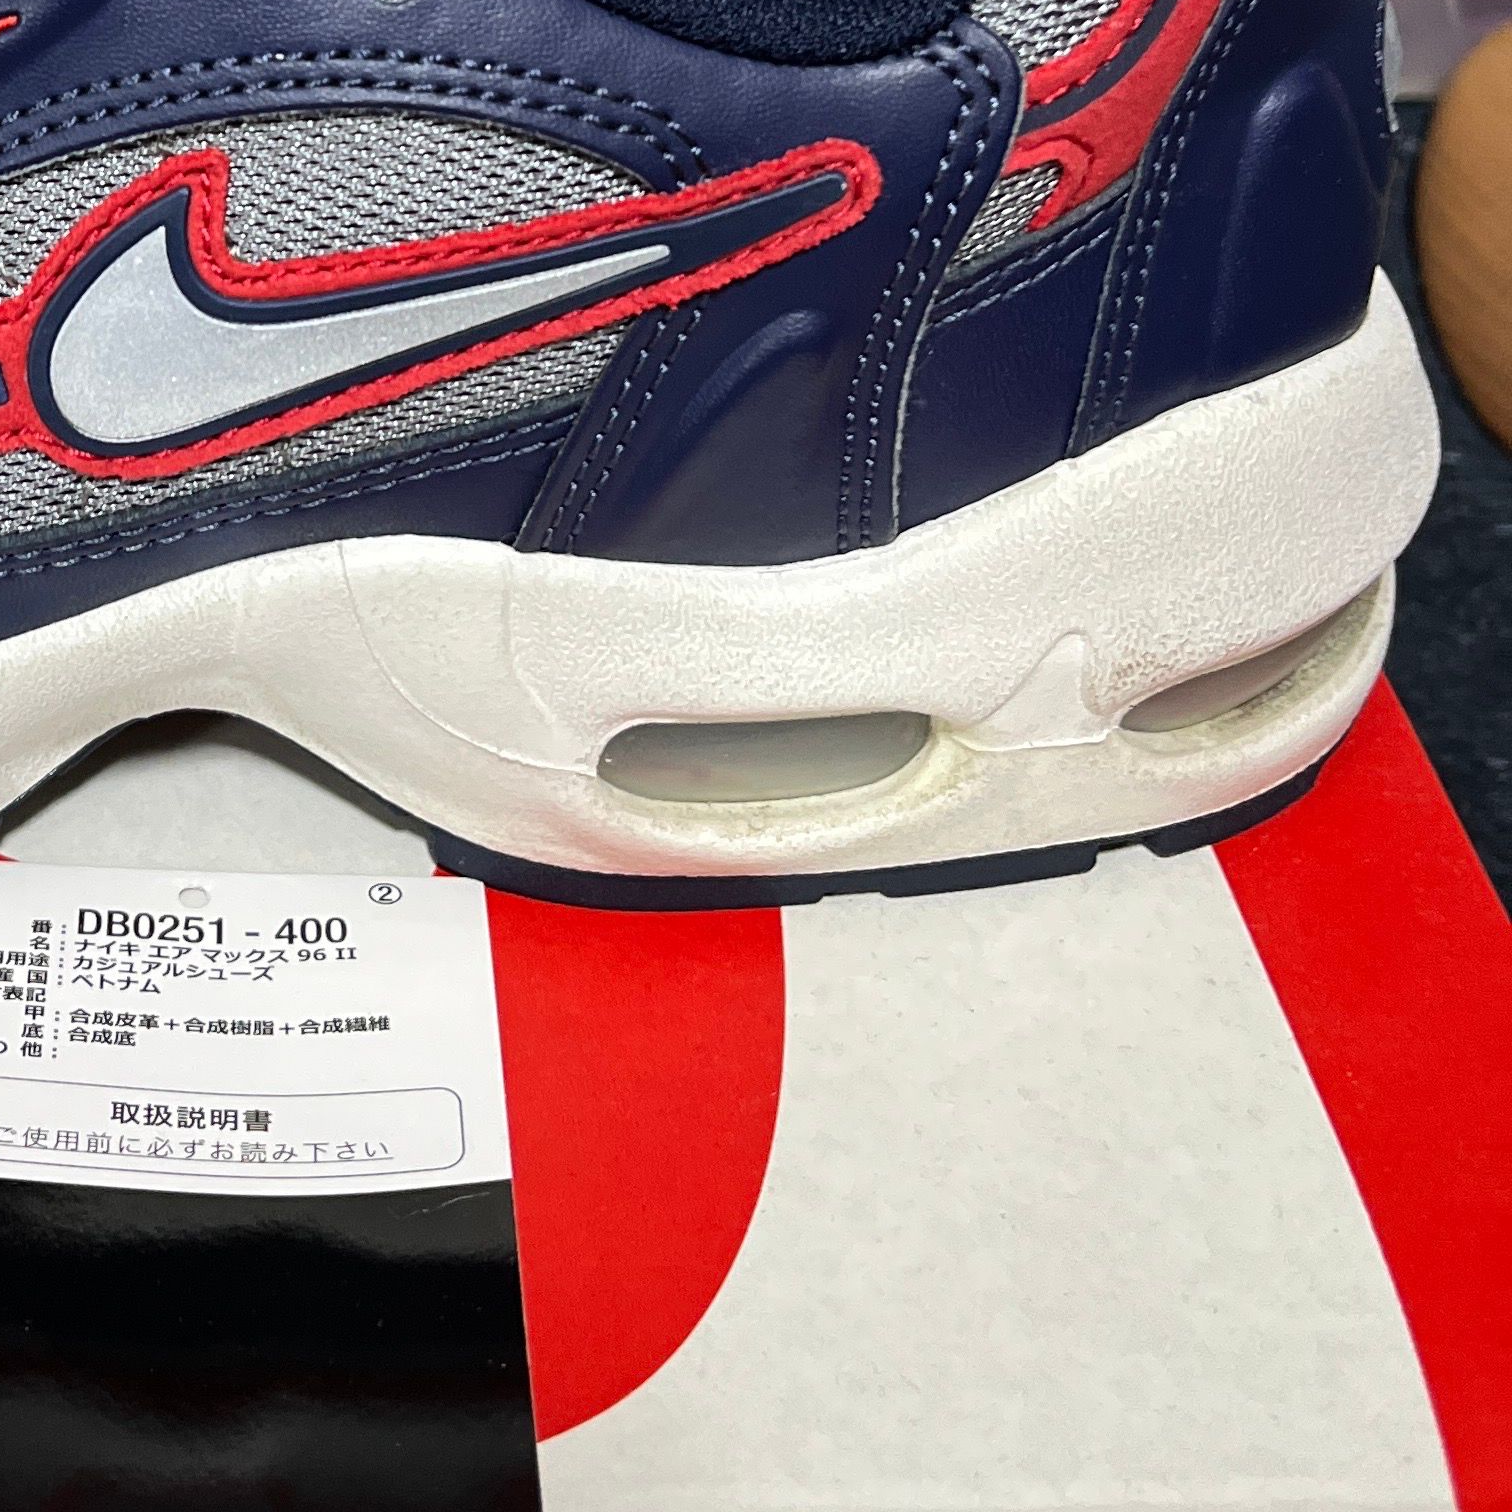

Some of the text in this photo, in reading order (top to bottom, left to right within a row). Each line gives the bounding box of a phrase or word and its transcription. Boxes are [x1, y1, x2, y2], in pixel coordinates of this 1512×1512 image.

[77, 908, 224, 944] DB0251
[275, 917, 348, 945] 400
[297, 948, 327, 962] 96
[109, 1100, 273, 1133] 取扱説明書
